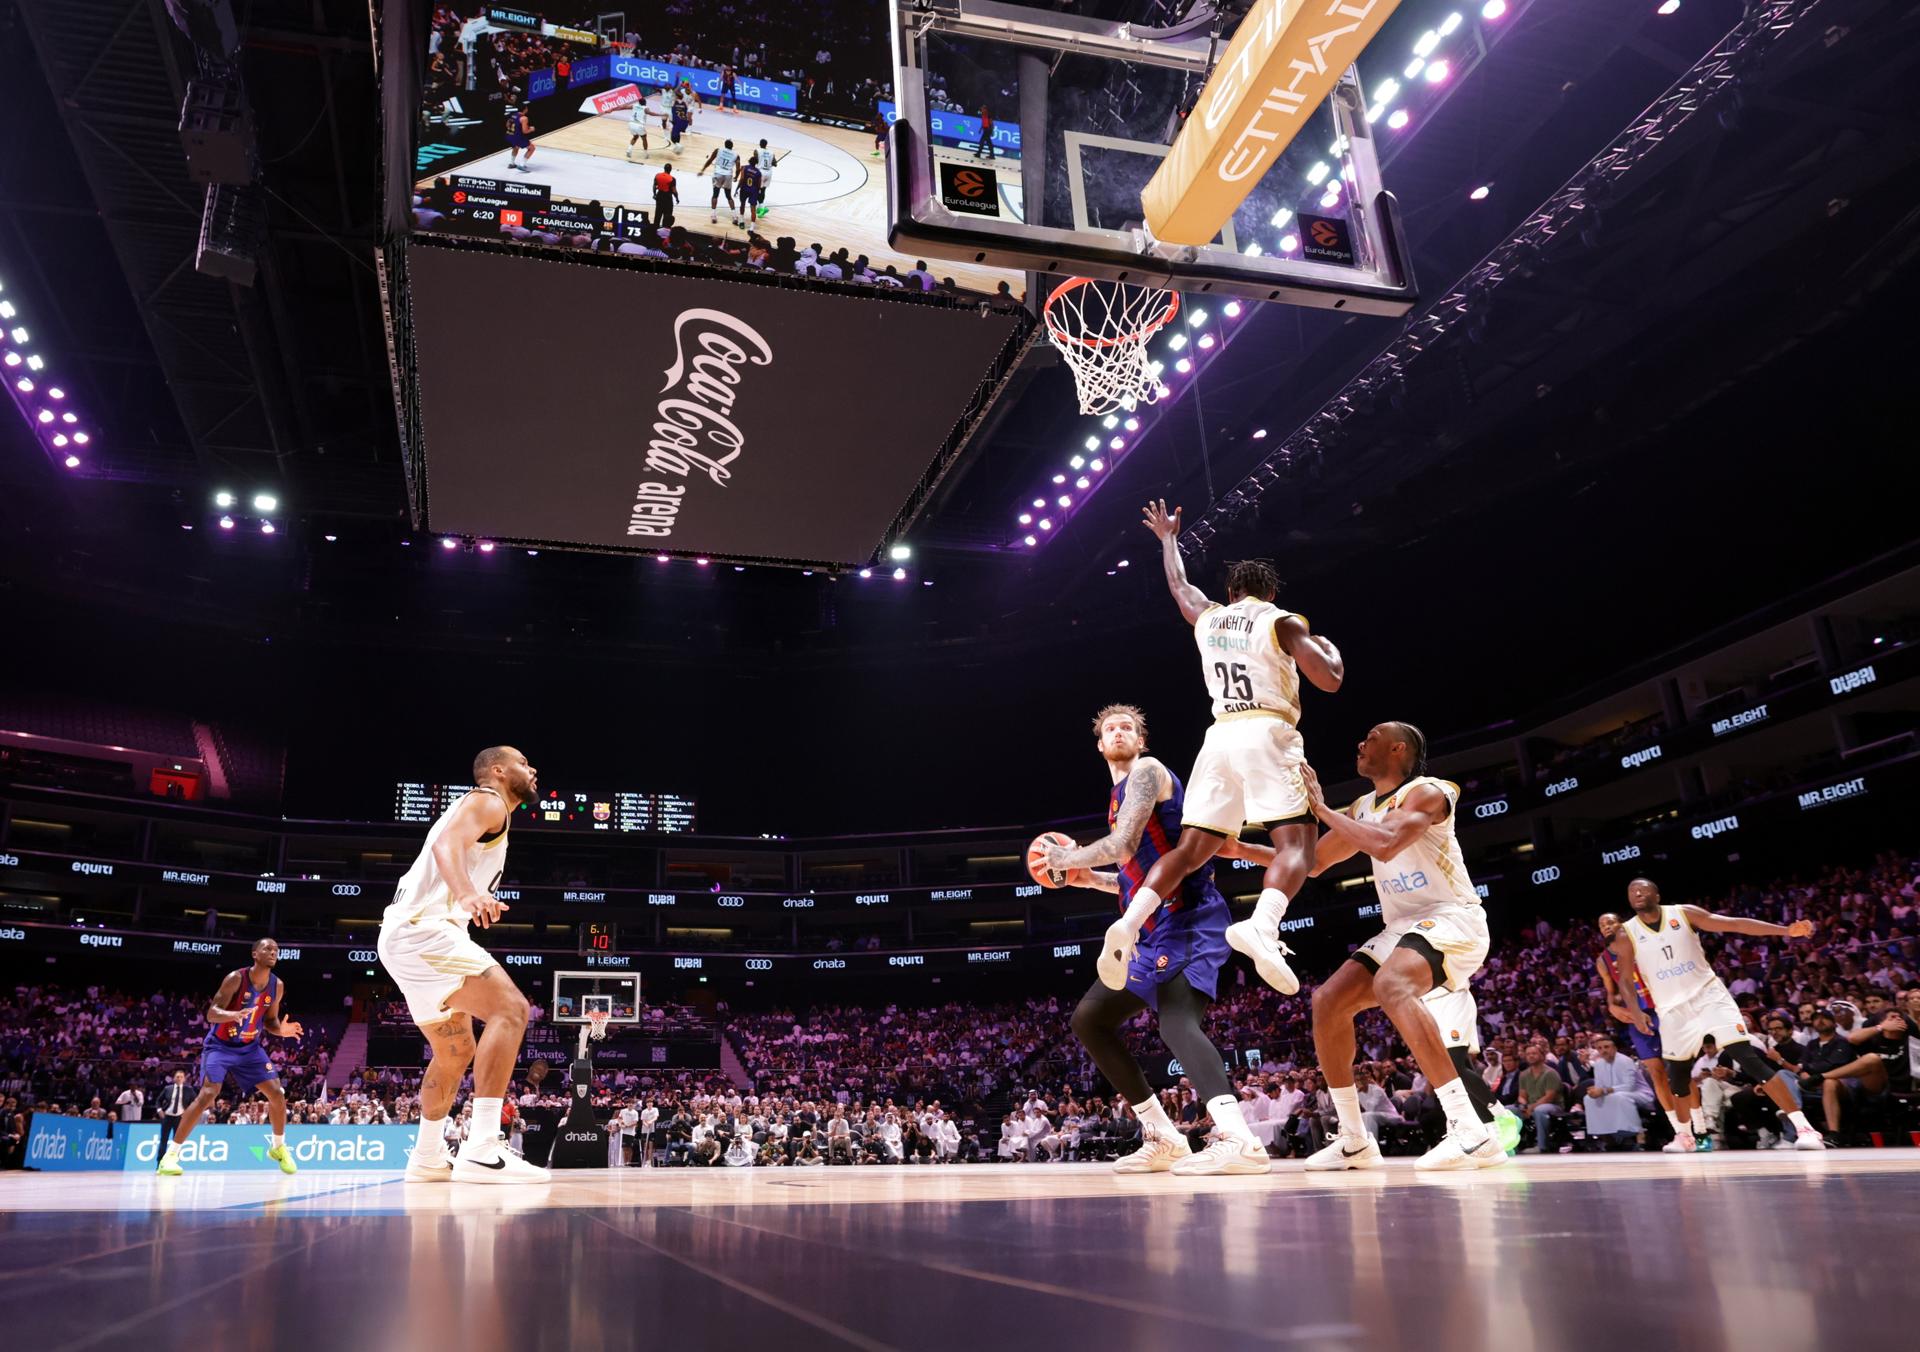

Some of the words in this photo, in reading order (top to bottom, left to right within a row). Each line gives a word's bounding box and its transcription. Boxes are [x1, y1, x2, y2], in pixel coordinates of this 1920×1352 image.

[490, 9, 536, 25] MR.EIGHT
[575, 65, 599, 81] dnata
[616, 61, 669, 82] dnata
[458, 178, 496, 187] ETIHAD
[468, 195, 508, 207] EuroLeague
[944, 196, 997, 210] EuroLeague
[473, 209, 494, 220] 6:20
[551, 204, 577, 214] DUBAI
[506, 214, 517, 222] 10
[532, 216, 543, 226] FC
[543, 217, 594, 231] BARCELONA
[627, 212, 643, 223] 84
[627, 226, 642, 237] 73
[1304, 245, 1350, 259] EuroLeague
[659, 308, 773, 488] Coca-Cola
[627, 482, 686, 537] arena
[1214, 661, 1254, 701] 25
[1830, 665, 1877, 695] DUBAI
[1712, 704, 1767, 734] MR.EIGHT
[1622, 746, 1662, 769] equiti
[549, 790, 558, 798] 4
[1545, 777, 1579, 797] dnata
[1798, 777, 1865, 808] MR.EIGHT
[574, 793, 588, 802] 73
[540, 800, 566, 810] 6:19
[1691, 815, 1739, 839] equiti
[72, 861, 113, 875] equiti
[162, 871, 210, 884] MR.EIGHT
[256, 880, 286, 894] DUBAI
[494, 888, 520, 900] quiti
[1015, 884, 1042, 898] DUBAI
[564, 892, 606, 901] MR.EIGHT
[649, 894, 676, 905] DUBAI
[855, 894, 889, 905] equiti
[931, 889, 972, 900] MR.EIGHT
[783, 897, 815, 908] dnata
[1279, 916, 1315, 933] equiti
[80, 934, 122, 948] equiti
[173, 940, 222, 953] MR.EIGHT
[593, 935, 609, 949] 10
[277, 946, 301, 960] UBAI
[967, 951, 1011, 963] MR.EIGHT
[1053, 944, 1081, 958] DUBAI
[1661, 944, 1674, 960] 17
[506, 955, 542, 967] equiti
[674, 957, 702, 970] DUBAI
[813, 958, 846, 969] dnata
[888, 955, 924, 967] equiti
[1656, 960, 1696, 981] dnata
[31, 1127, 67, 1160] dnata
[564, 1131, 598, 1142] dnata
[85, 1131, 113, 1161] dnata
[136, 1134, 229, 1162] data
[288, 1134, 385, 1161] dnata
